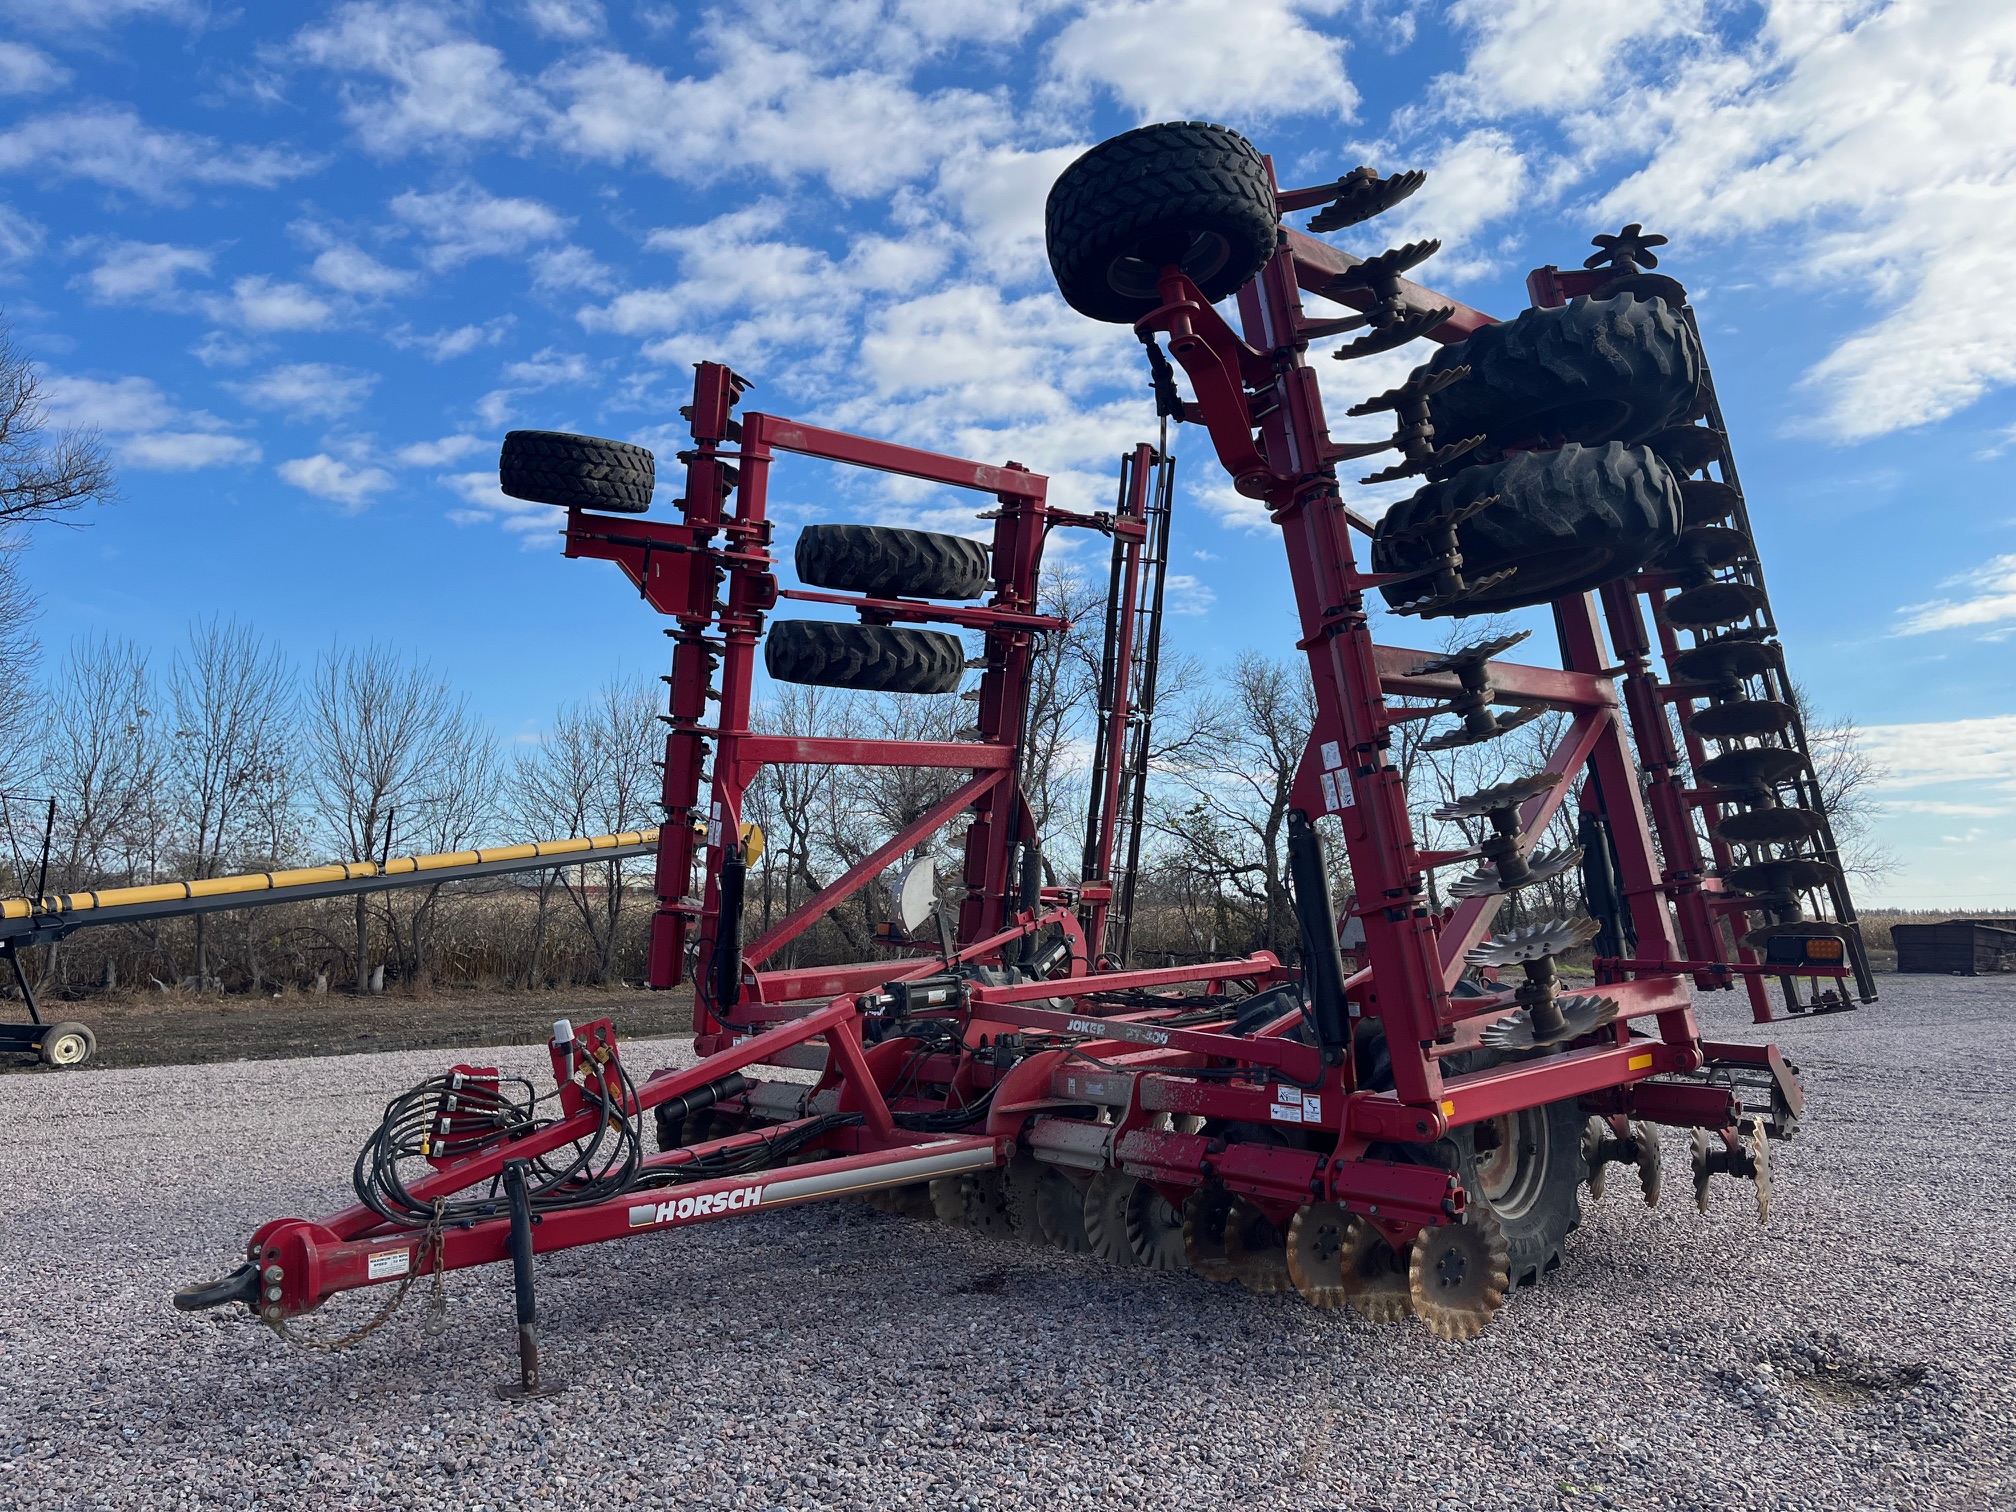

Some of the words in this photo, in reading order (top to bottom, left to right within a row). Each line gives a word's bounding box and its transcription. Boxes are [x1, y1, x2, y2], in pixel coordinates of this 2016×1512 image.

[896, 893, 901, 903] 3
[1067, 1020, 1105, 1035] JOKER
[655, 1186, 763, 1223] HORSCH
